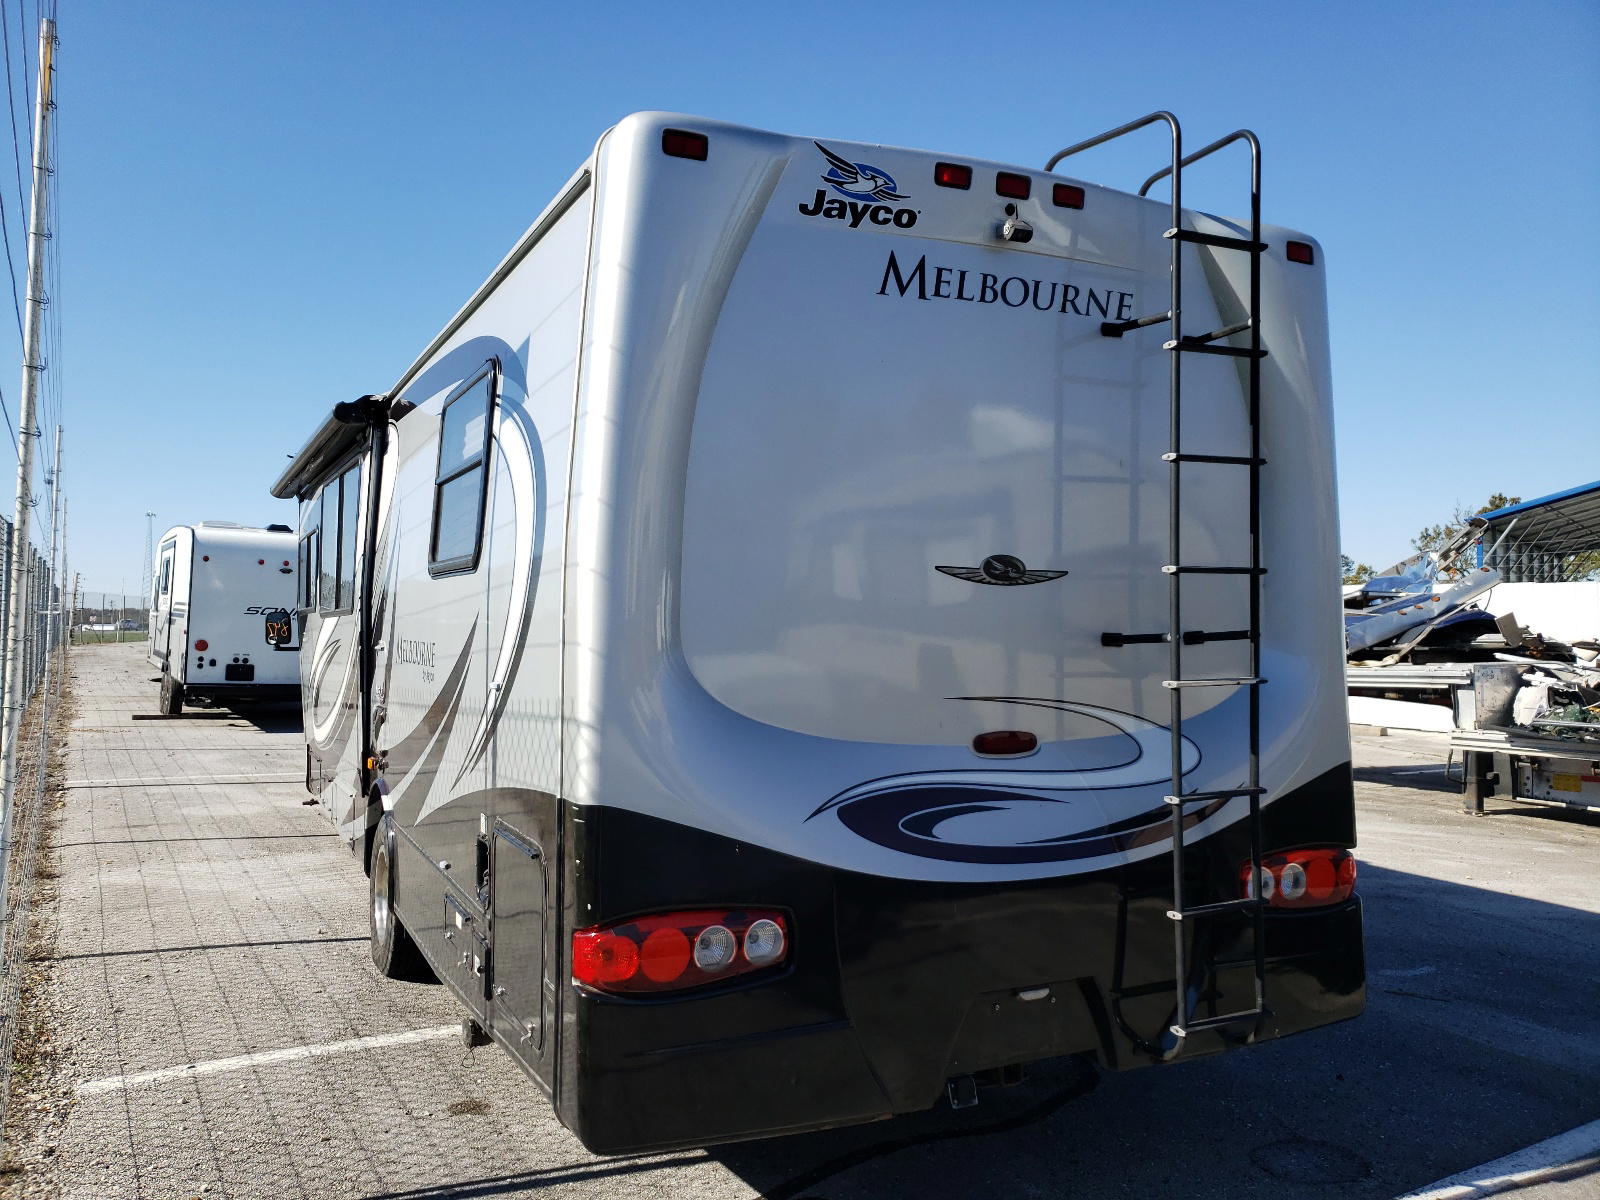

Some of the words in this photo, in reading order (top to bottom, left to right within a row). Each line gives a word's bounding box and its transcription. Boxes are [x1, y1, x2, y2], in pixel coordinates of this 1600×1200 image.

[798, 189, 918, 229] Jayco
[875, 249, 1135, 322] MELBOURNE
[395, 633, 436, 668] MELBOURNE
